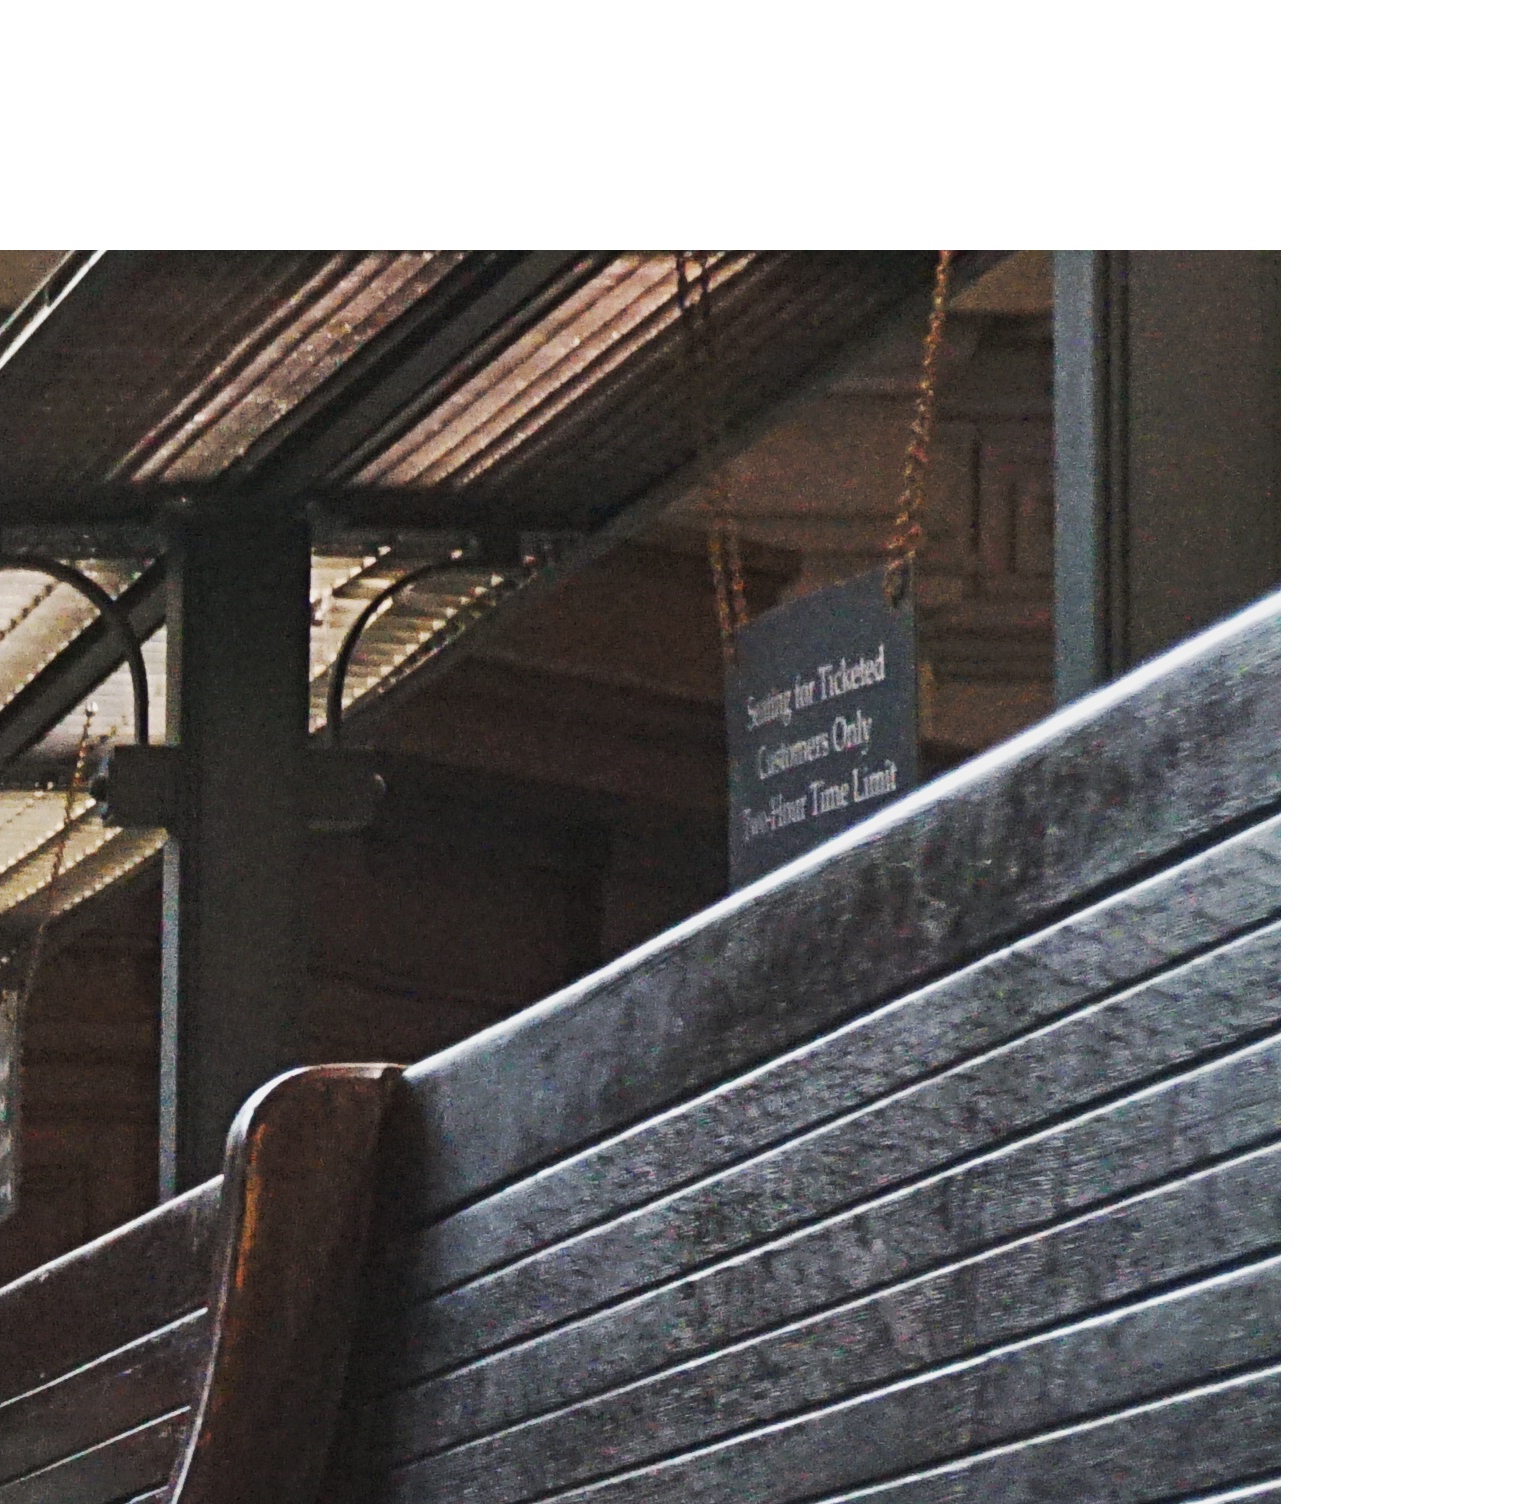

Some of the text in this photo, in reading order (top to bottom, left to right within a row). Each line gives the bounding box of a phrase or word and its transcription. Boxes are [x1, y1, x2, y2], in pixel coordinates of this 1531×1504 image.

[794, 674, 815, 710] for
[817, 643, 886, 701] Ticketed
[759, 709, 873, 781] Customers Only
[809, 780, 850, 817] Time
[852, 759, 898, 803] Limit
